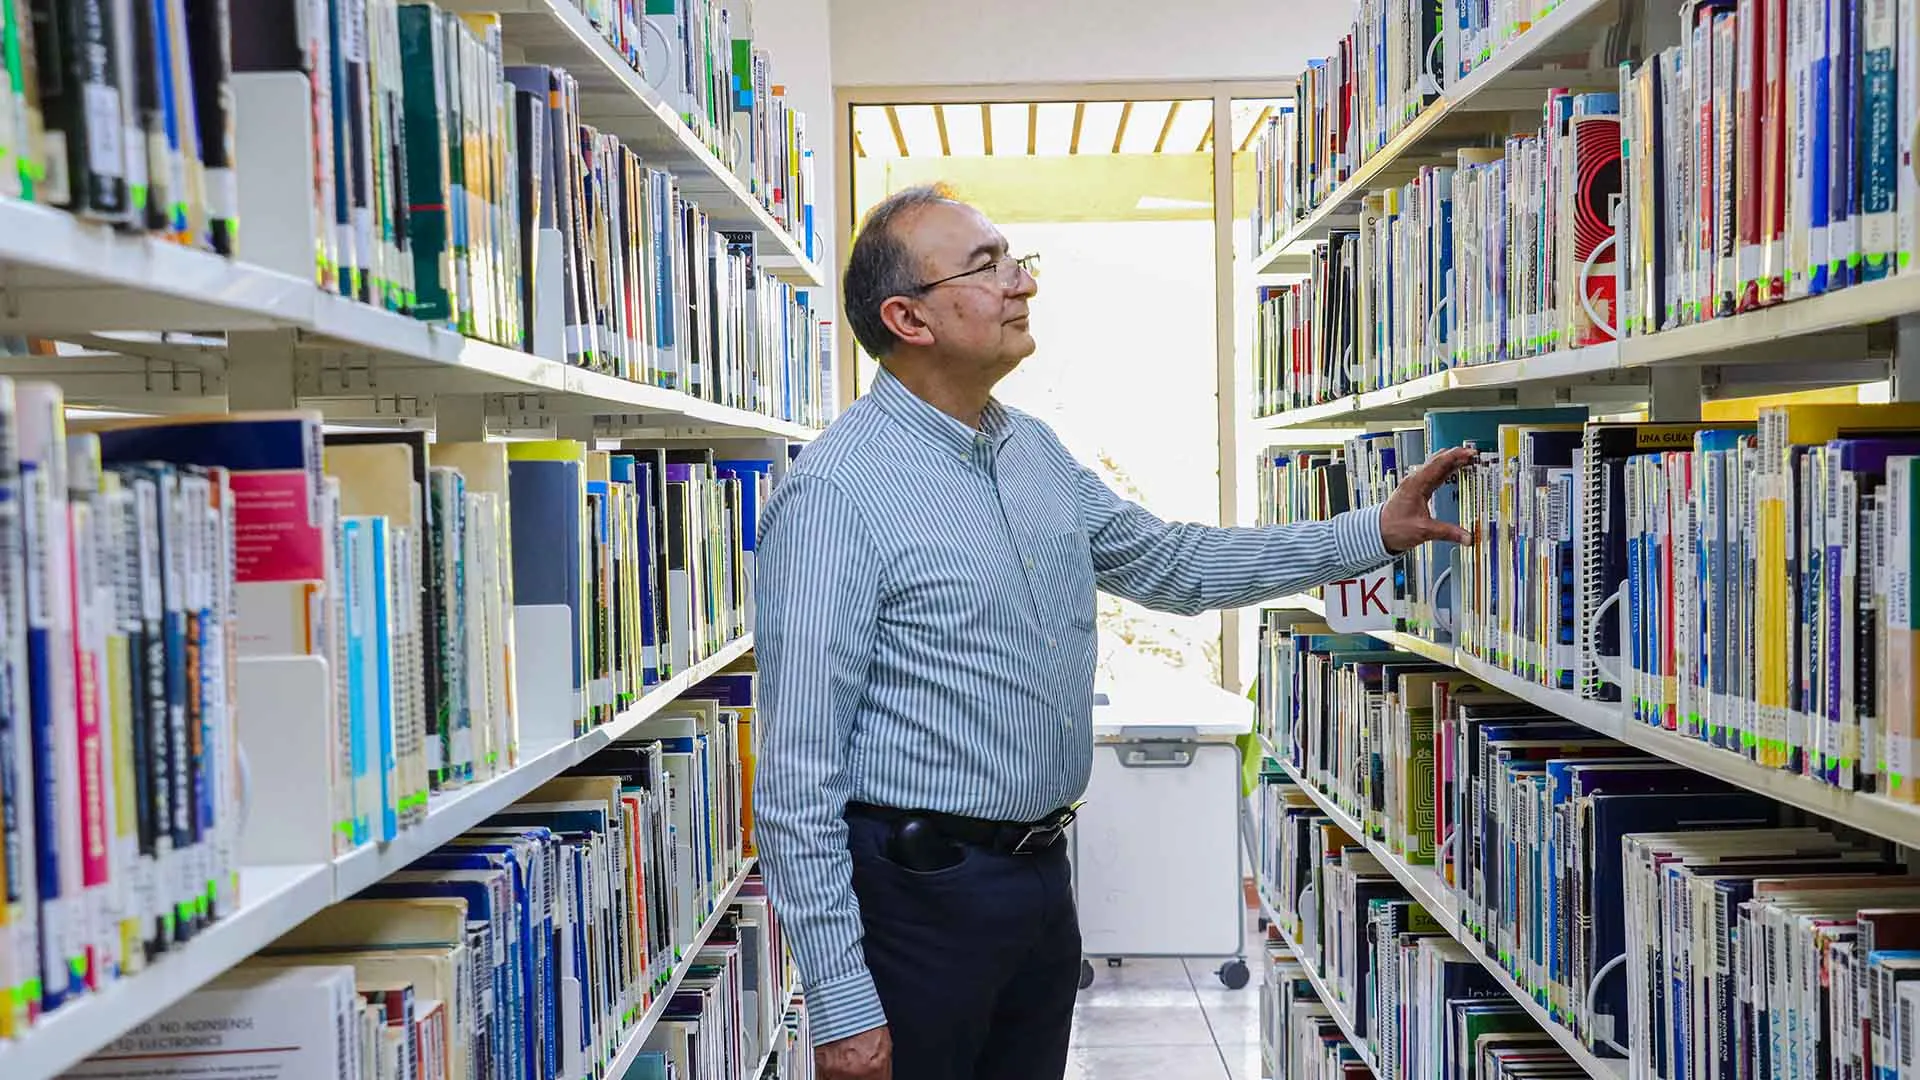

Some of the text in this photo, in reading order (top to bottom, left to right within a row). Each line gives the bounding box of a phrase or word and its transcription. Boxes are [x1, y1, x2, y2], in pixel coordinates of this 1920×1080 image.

[1701, 111, 1710, 188] Processing
[1639, 433, 1660, 443] UNA
[1328, 576, 1389, 616] TK
[1897, 571, 1908, 624] Digital
[138, 1034, 224, 1049] ELECTRONICS
